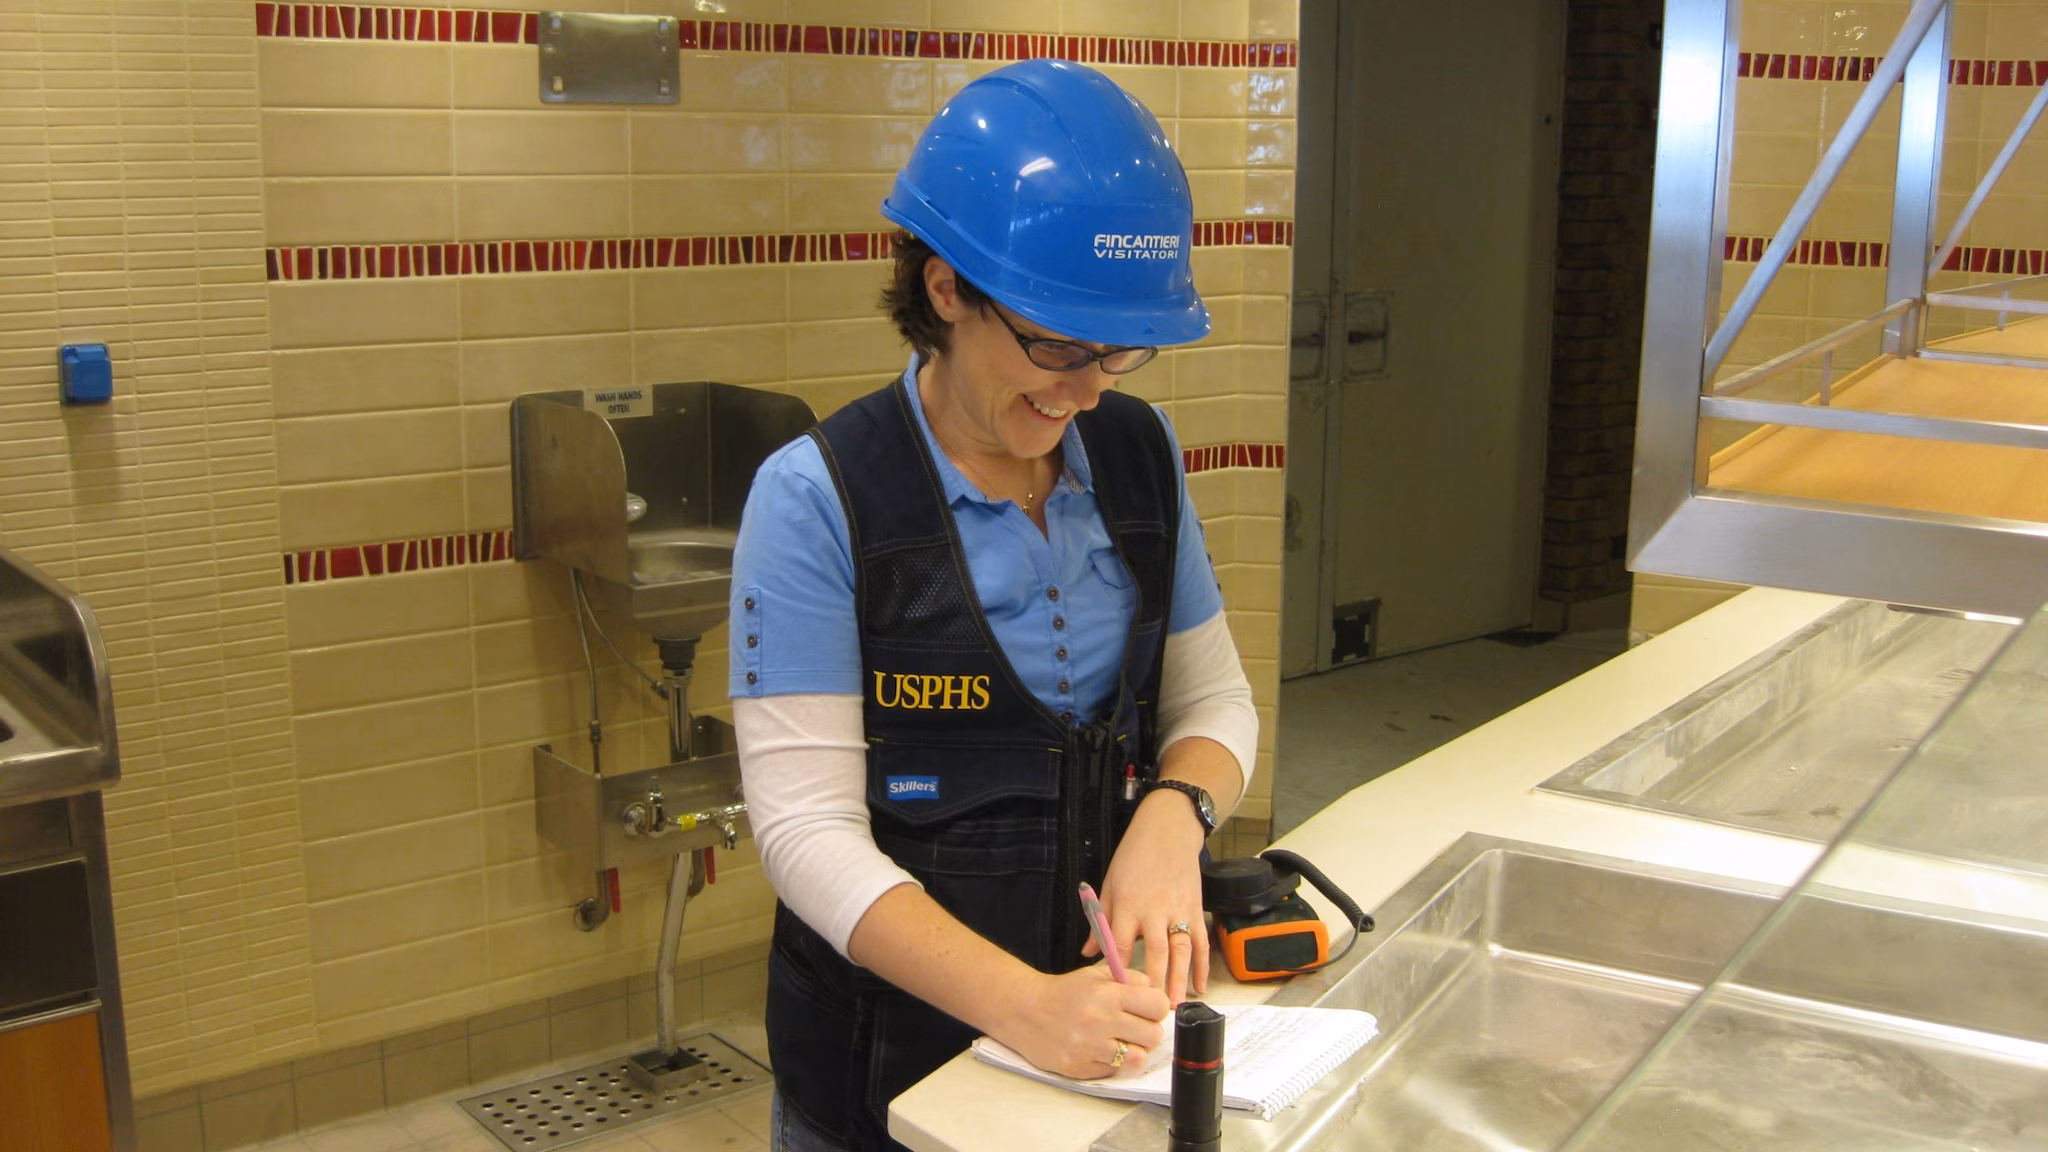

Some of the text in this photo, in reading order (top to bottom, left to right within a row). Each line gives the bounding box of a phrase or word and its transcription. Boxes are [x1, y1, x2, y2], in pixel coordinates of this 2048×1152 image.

[1093, 234, 1180, 248] FINCANTIERI
[1093, 248, 1178, 259] VISITATORI
[595, 390, 642, 402] WASH HANDS
[608, 403, 631, 414] OFTEN
[873, 670, 990, 709] USPHS
